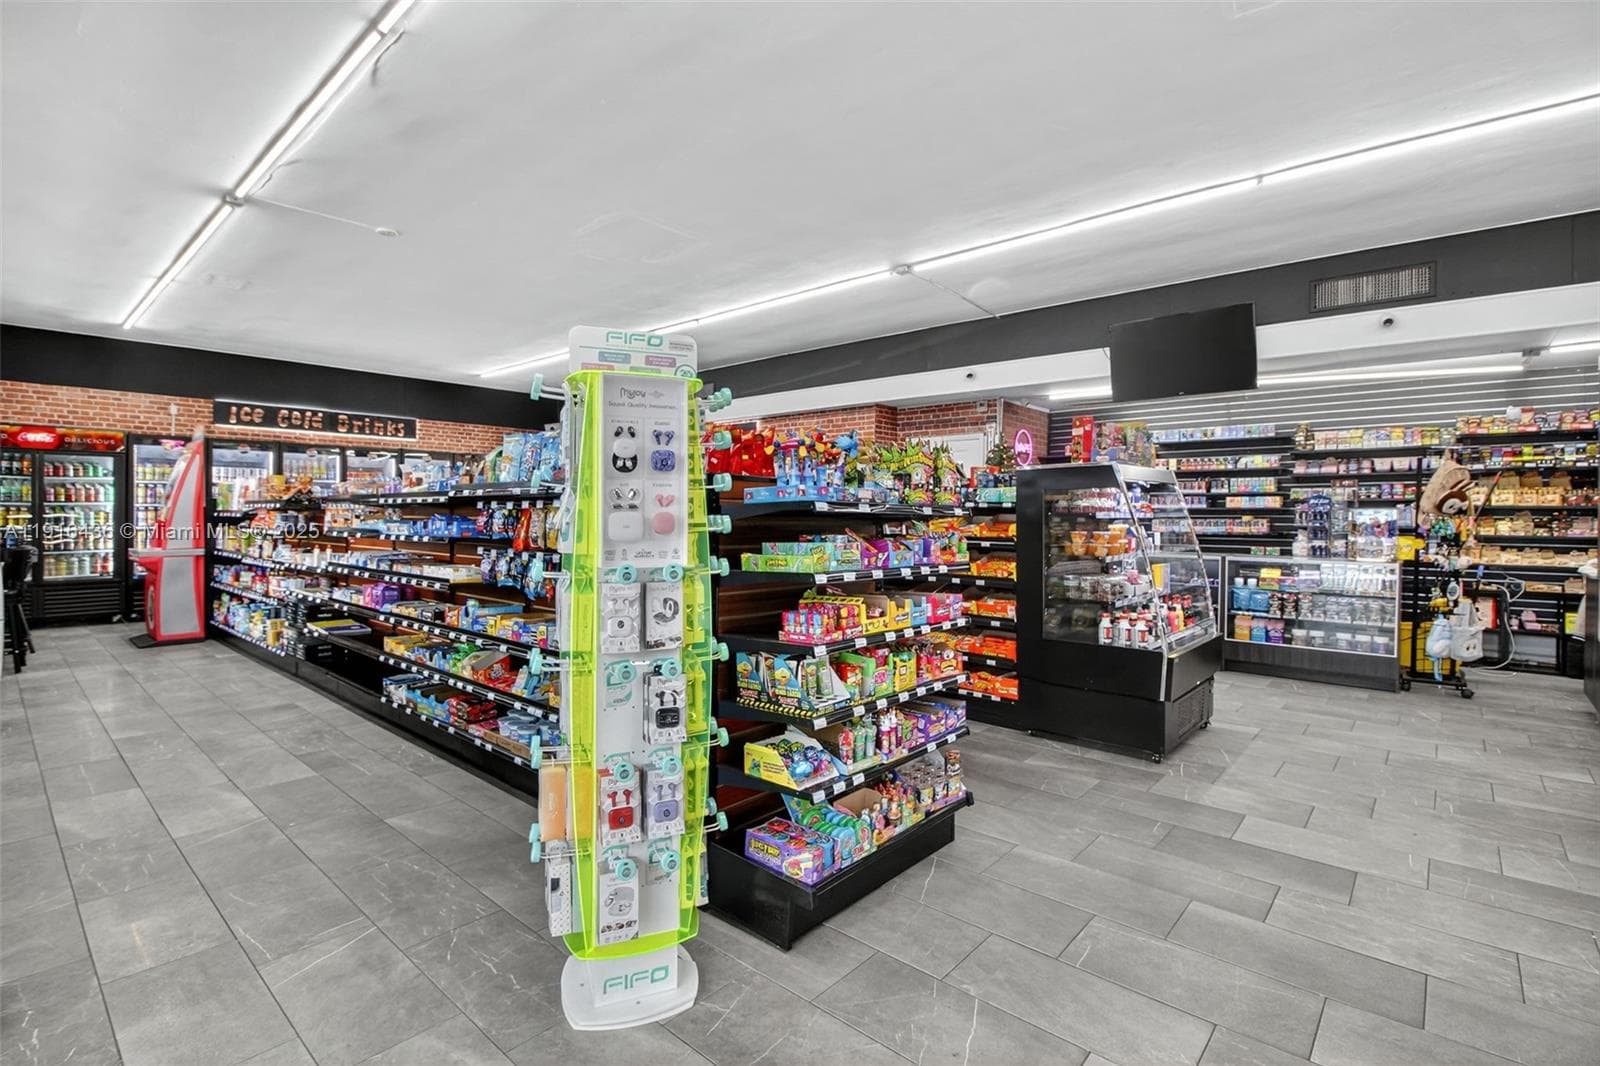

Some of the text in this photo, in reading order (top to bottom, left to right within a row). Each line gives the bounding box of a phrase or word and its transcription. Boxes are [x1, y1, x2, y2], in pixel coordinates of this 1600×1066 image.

[606, 331, 664, 347] FIFO
[228, 406, 405, 437] Ice Cold Drinks
[63, 436, 116, 446] DELICIOUS
[603, 965, 670, 995] FIFO
